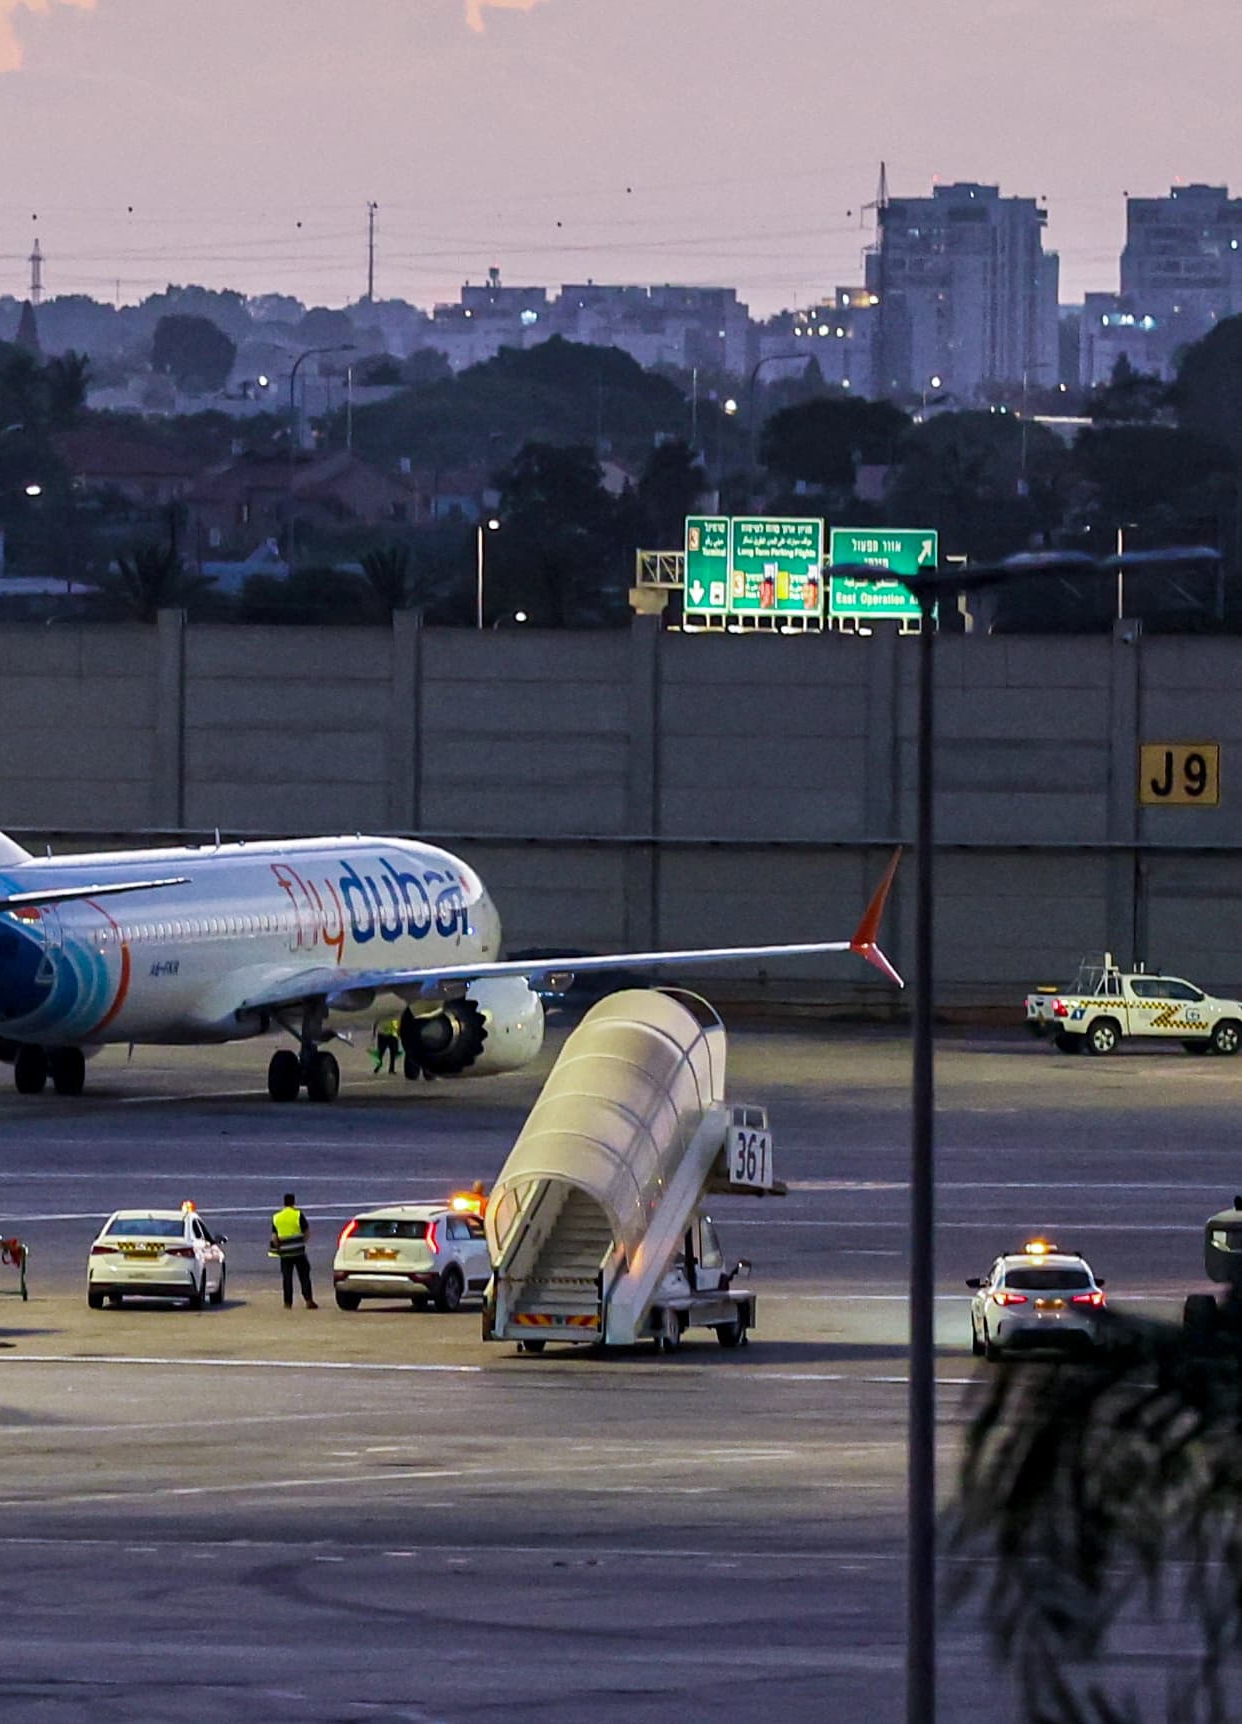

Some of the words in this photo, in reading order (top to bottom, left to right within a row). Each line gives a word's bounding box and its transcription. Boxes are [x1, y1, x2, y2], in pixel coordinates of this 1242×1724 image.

[835, 592, 856, 605] East
[860, 592, 905, 609] Operation
[269, 857, 471, 965] flydubai
[735, 1132, 766, 1183] 361
